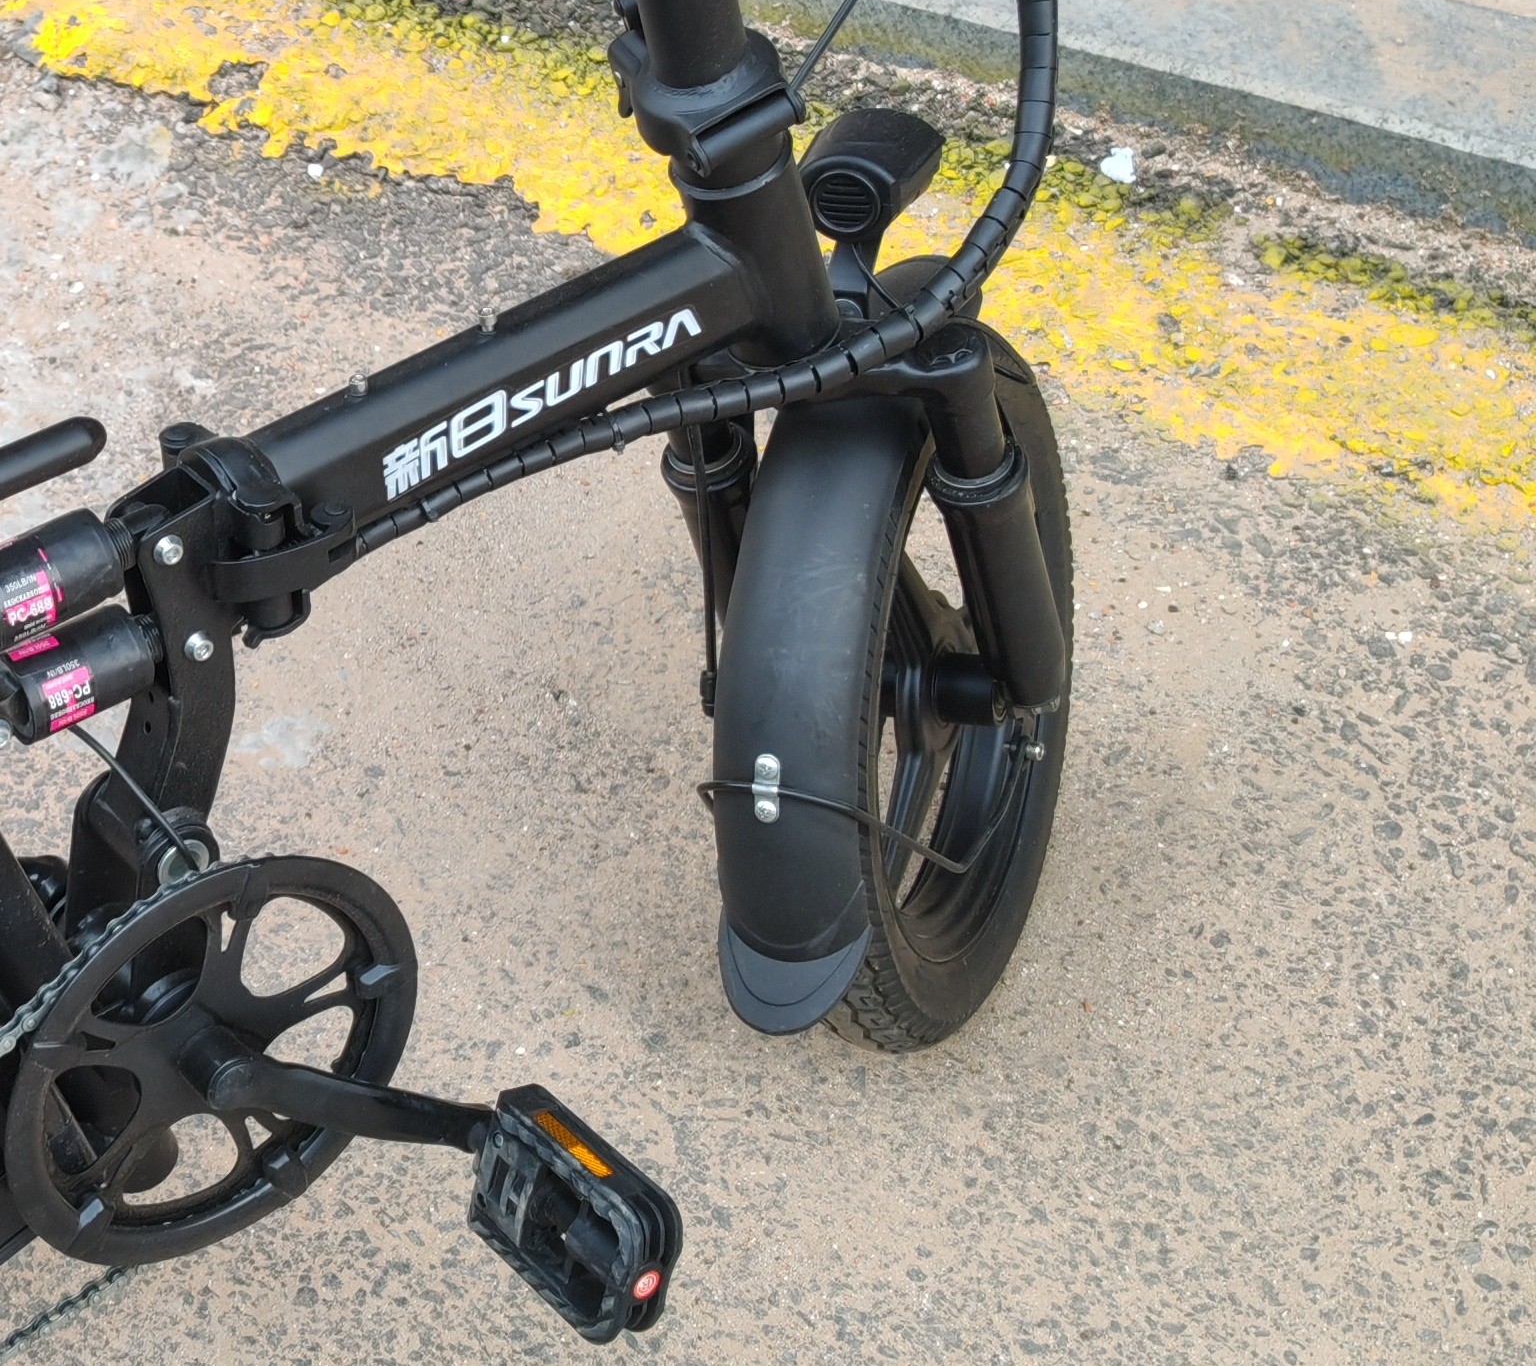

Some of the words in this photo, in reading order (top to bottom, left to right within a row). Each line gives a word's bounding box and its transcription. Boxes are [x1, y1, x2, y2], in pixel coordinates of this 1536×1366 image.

[382, 389, 507, 502] 新日
[6, 596, 54, 626] PC-688
[47, 680, 91, 710] PC-688
